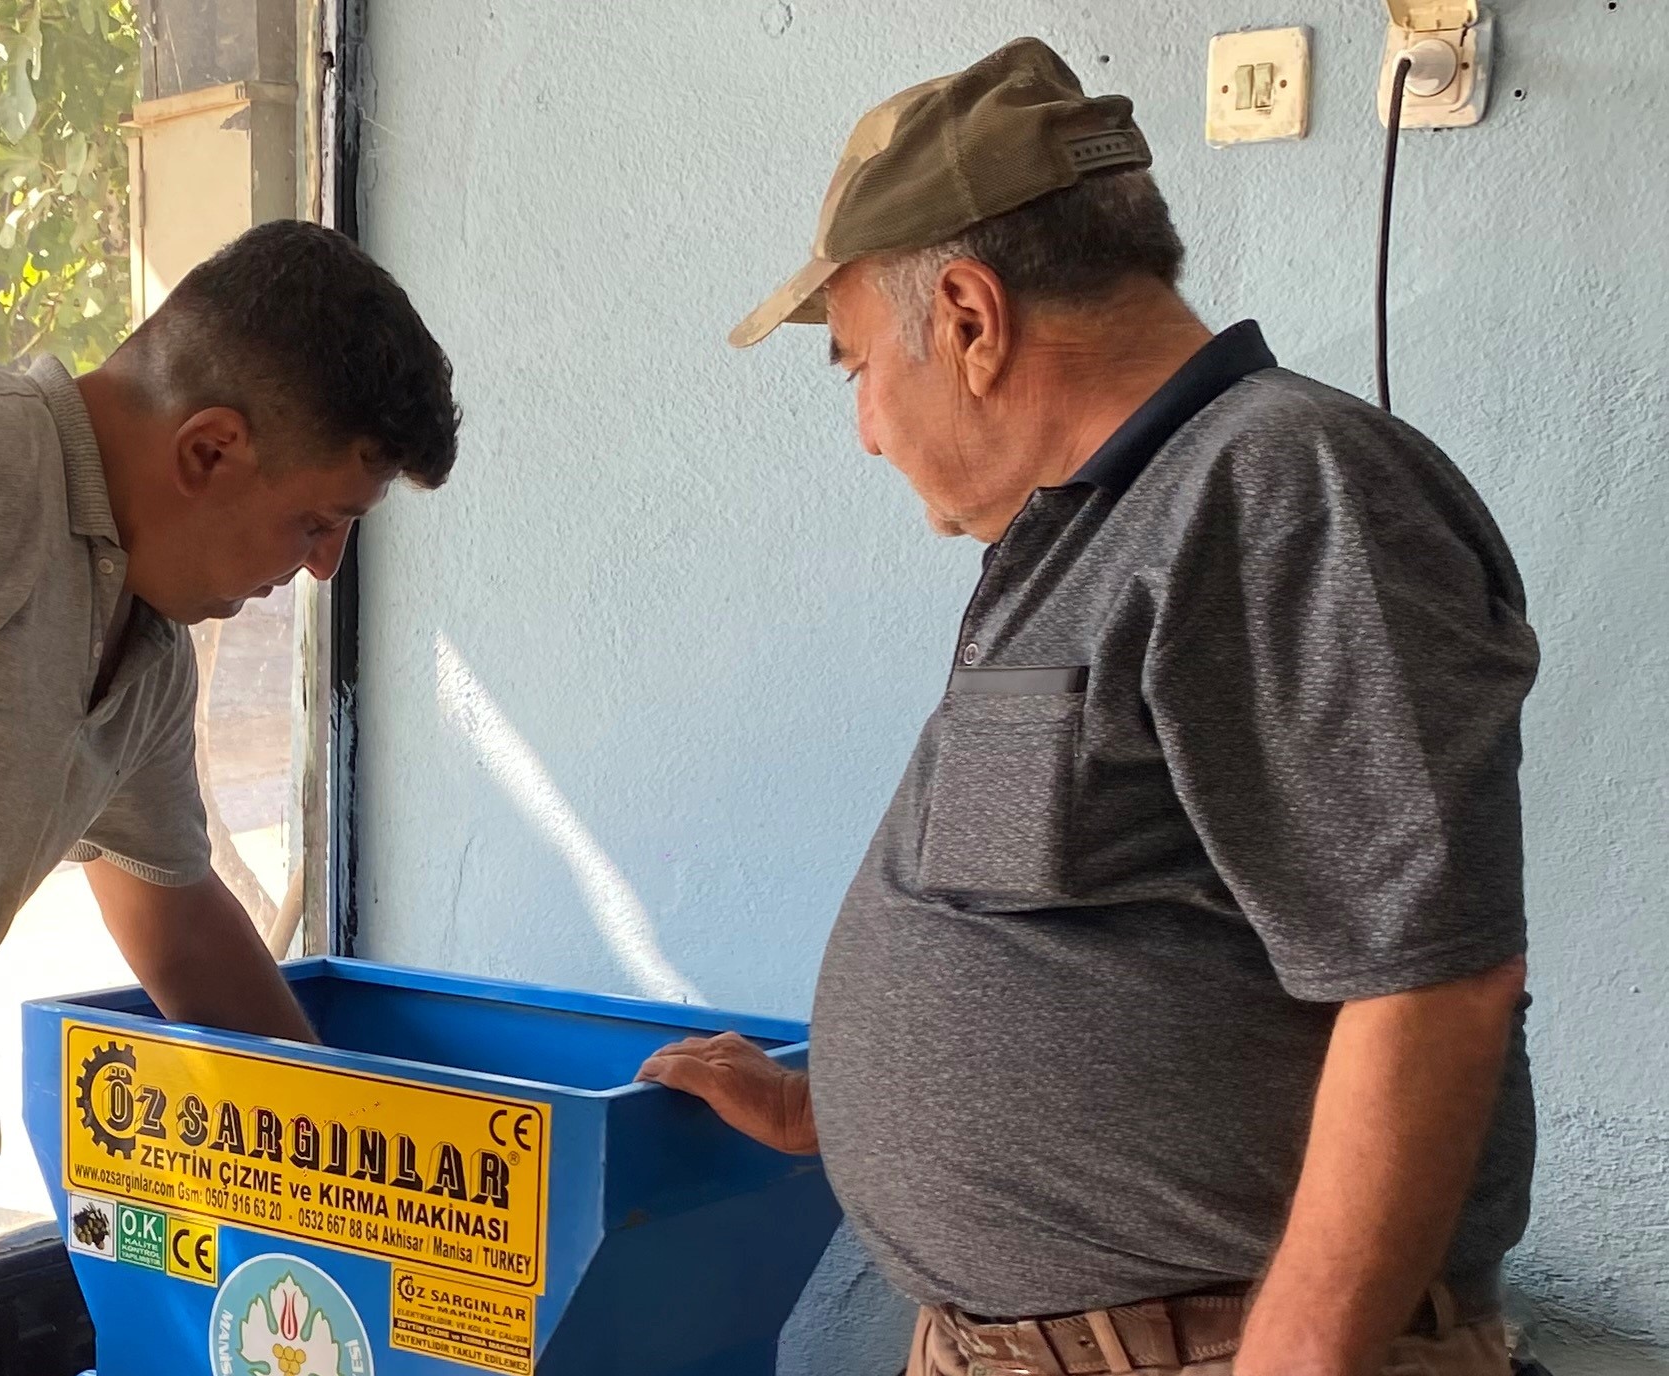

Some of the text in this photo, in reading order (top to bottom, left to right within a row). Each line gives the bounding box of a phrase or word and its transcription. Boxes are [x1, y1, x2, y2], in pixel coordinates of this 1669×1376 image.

[176, 1092, 510, 1210] SARGINLAR
[139, 1143, 509, 1244] ZEYTİN ÇİZME ve KIRMA MAKİNASI
[74, 1162, 175, 1199] www.ozsarginlar.com
[177, 1180, 203, 1203] Gsm:
[205, 1186, 230, 1210] 0507
[232, 1193, 251, 1216] 916
[253, 1197, 267, 1219] 63
[269, 1201, 283, 1222] 20
[298, 1207, 325, 1231] 0532
[326, 1213, 347, 1235] 667
[349, 1218, 364, 1240] 88
[365, 1221, 380, 1243] 64
[381, 1224, 425, 1254] Akhisar
[433, 1235, 474, 1264] Manisa
[482, 1246, 533, 1277] TURKEY
[121, 1209, 163, 1244] O.K.
[121, 1243, 161, 1260] KONTROL
[172, 1228, 213, 1275] CE
[430, 1288, 527, 1322] SARGINLAR
[437, 1305, 492, 1324] MAKİNA
[394, 1332, 450, 1353] PATENTLİDİR
[484, 1353, 528, 1372] EDİLEMEZ
